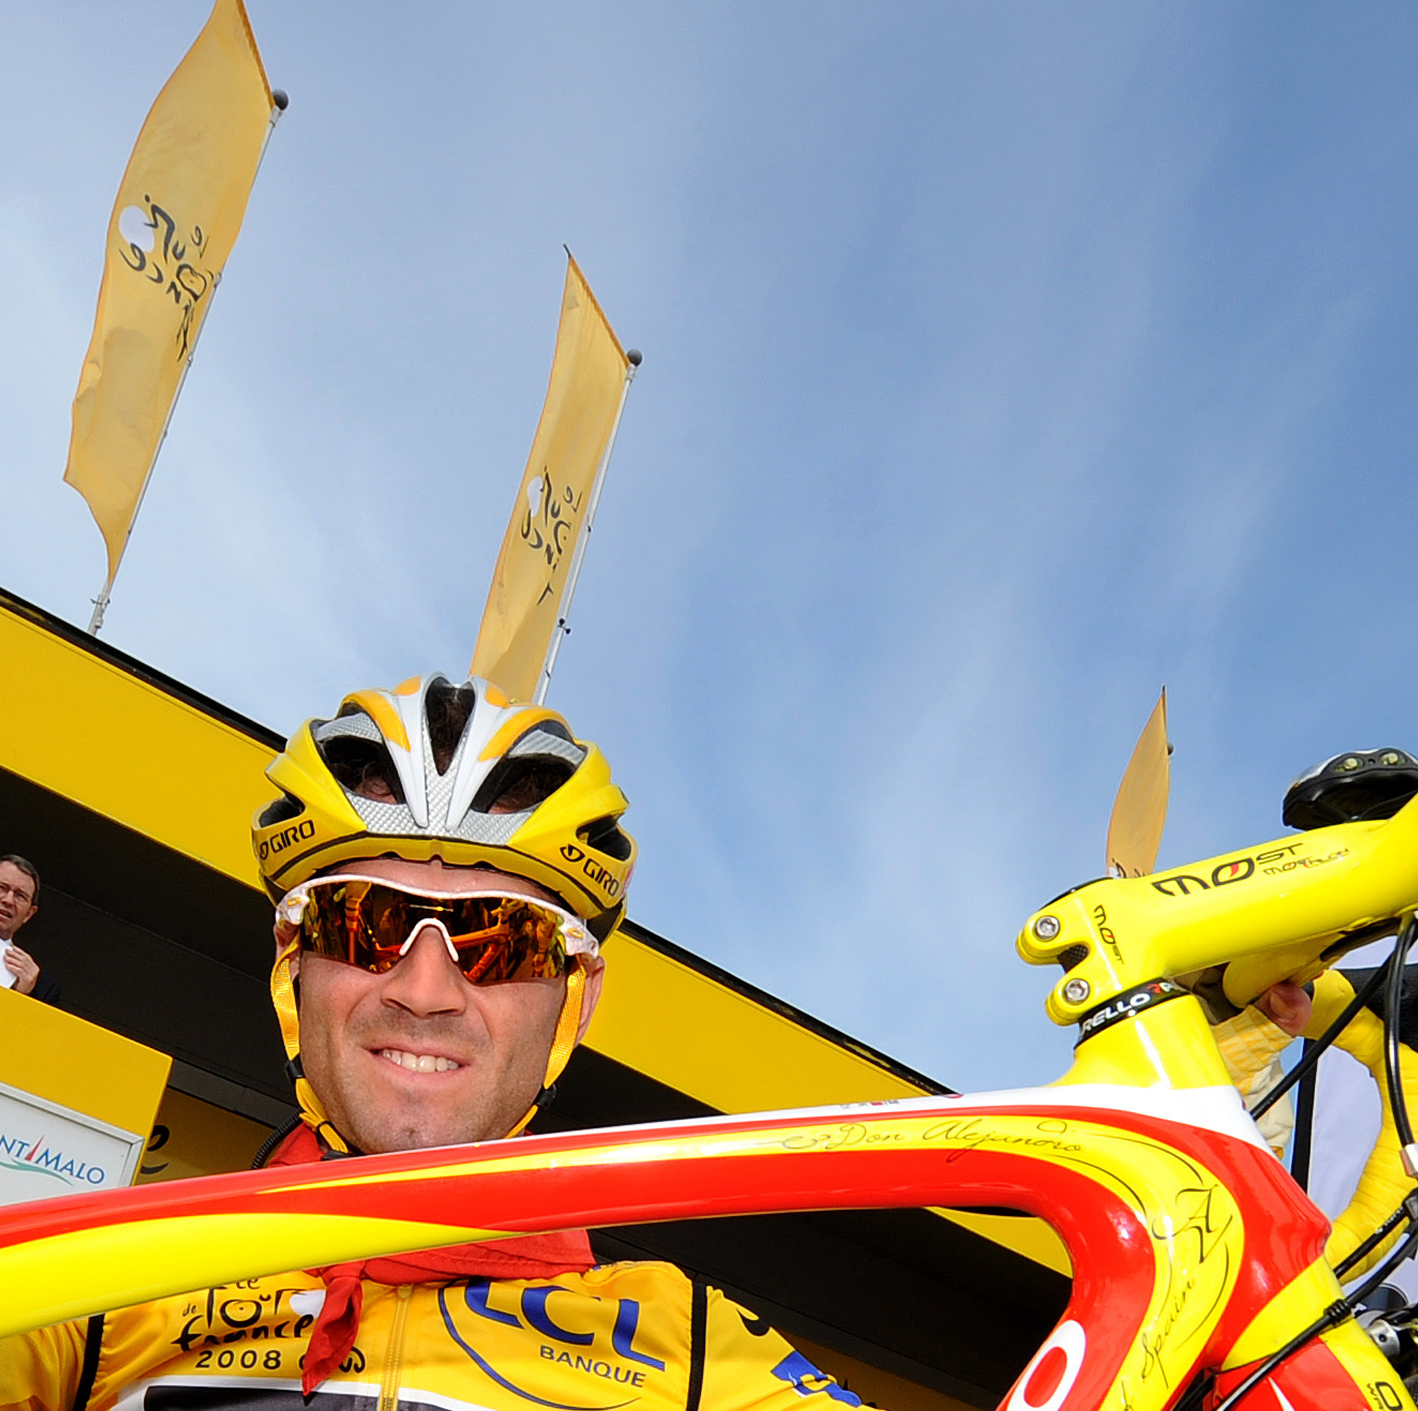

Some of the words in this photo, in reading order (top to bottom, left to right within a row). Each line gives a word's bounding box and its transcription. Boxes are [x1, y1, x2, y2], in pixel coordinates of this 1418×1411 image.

[270, 819, 316, 854] GIRO
[583, 858, 620, 897] GIRO
[36, 1148, 106, 1185] MALO
[195, 1348, 282, 1371] 2008
[539, 1344, 648, 1390] BANQUE
